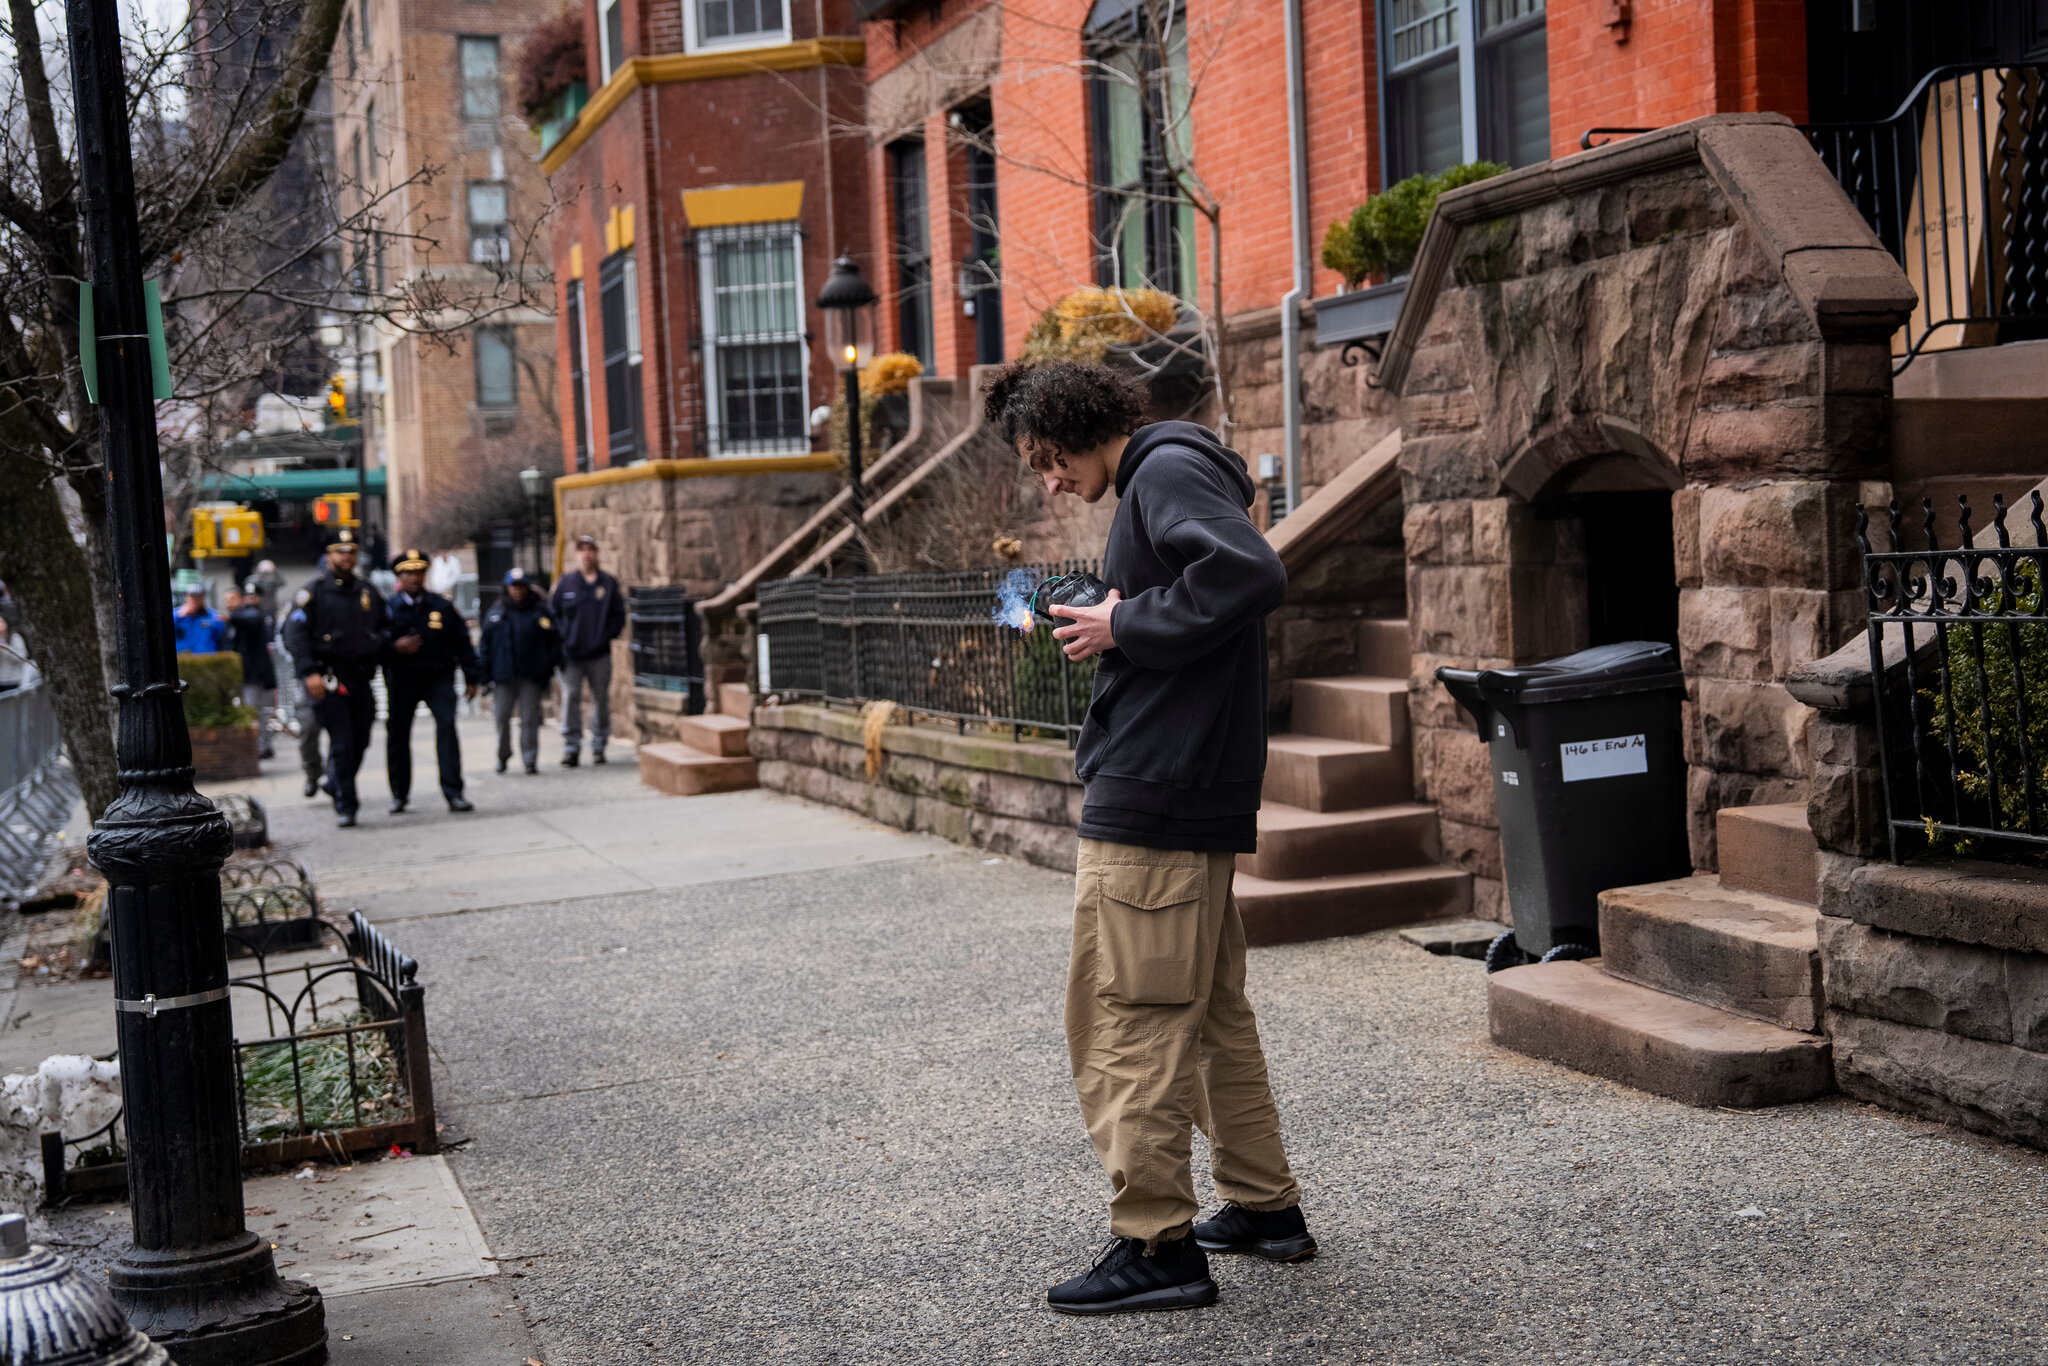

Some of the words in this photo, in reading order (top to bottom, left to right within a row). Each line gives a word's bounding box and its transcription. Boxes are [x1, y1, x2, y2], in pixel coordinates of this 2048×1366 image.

[1913, 221, 1937, 237] CHIR
[1937, 214, 1976, 231] FLDIG
[1565, 745, 1588, 756] 146
[1605, 739, 1627, 750] End
